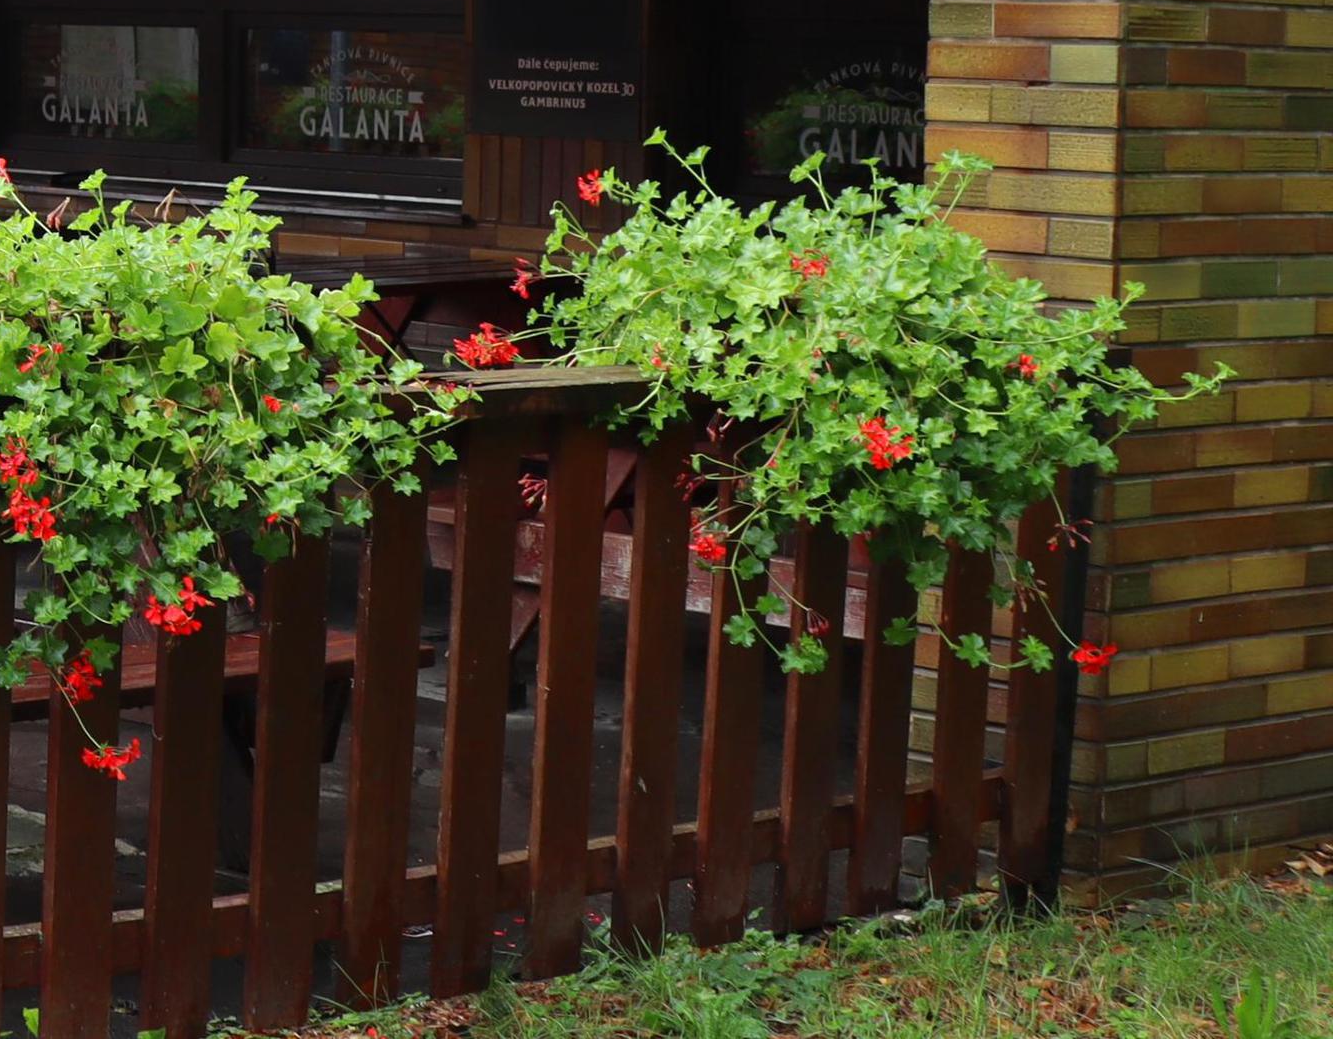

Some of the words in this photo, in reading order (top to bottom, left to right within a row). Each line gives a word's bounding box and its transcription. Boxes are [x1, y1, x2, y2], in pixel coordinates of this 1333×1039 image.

[517, 57, 541, 69] Dále
[320, 85, 403, 106] RESTAURACE
[488, 78, 584, 92] VELKOPOPOVICKÝ
[586, 82, 620, 95] KOZEL
[42, 93, 149, 128] GALANTA
[520, 96, 586, 109] GAMBRINUS
[299, 105, 425, 144] GALANTA
